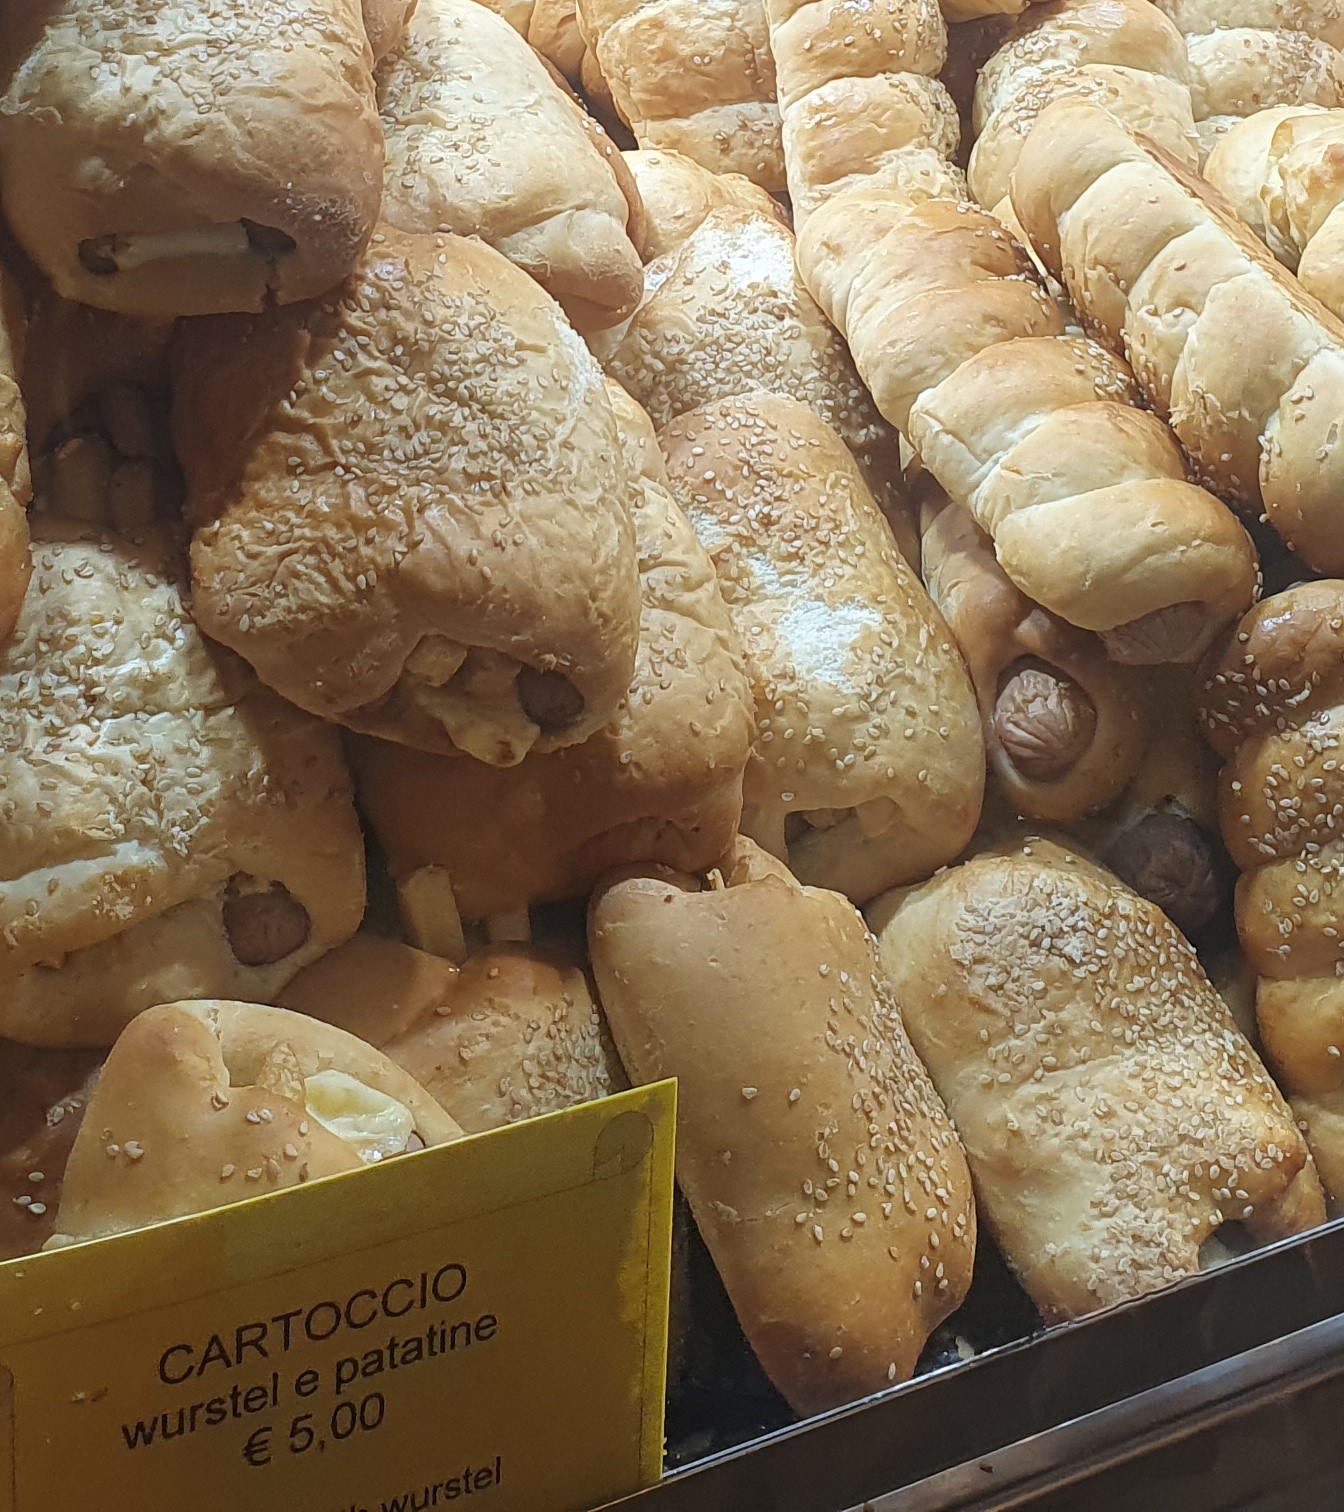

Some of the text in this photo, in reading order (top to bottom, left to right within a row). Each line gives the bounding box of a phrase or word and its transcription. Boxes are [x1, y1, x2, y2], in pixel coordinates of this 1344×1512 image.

[158, 1263, 467, 1385] CARTOCCIO
[121, 1313, 498, 1449] wurstel e patatine
[242, 1393, 385, 1467] € 5,00
[380, 1456, 501, 1512] wurstel
